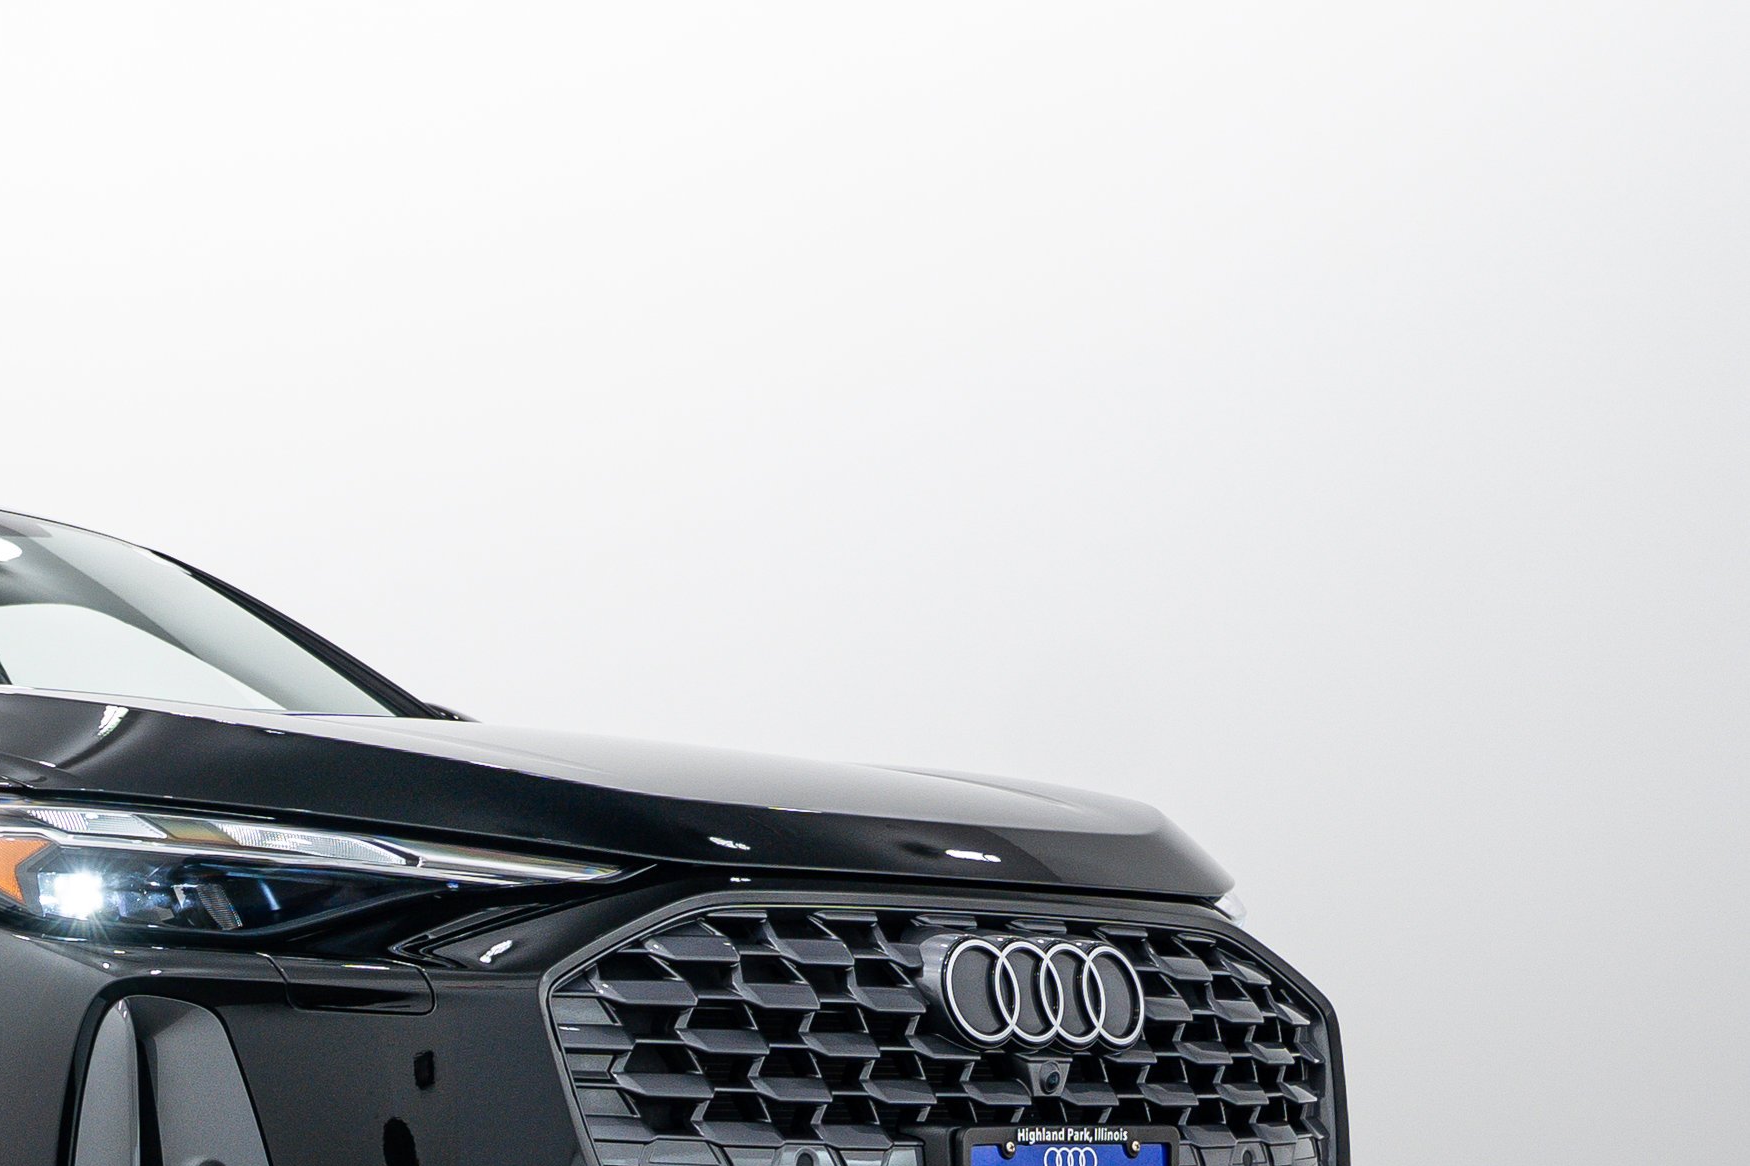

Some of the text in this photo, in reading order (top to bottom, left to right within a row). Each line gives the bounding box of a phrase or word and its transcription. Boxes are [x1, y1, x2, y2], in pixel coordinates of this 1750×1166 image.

[1017, 1127, 1128, 1144] Highland Park, Illinois
